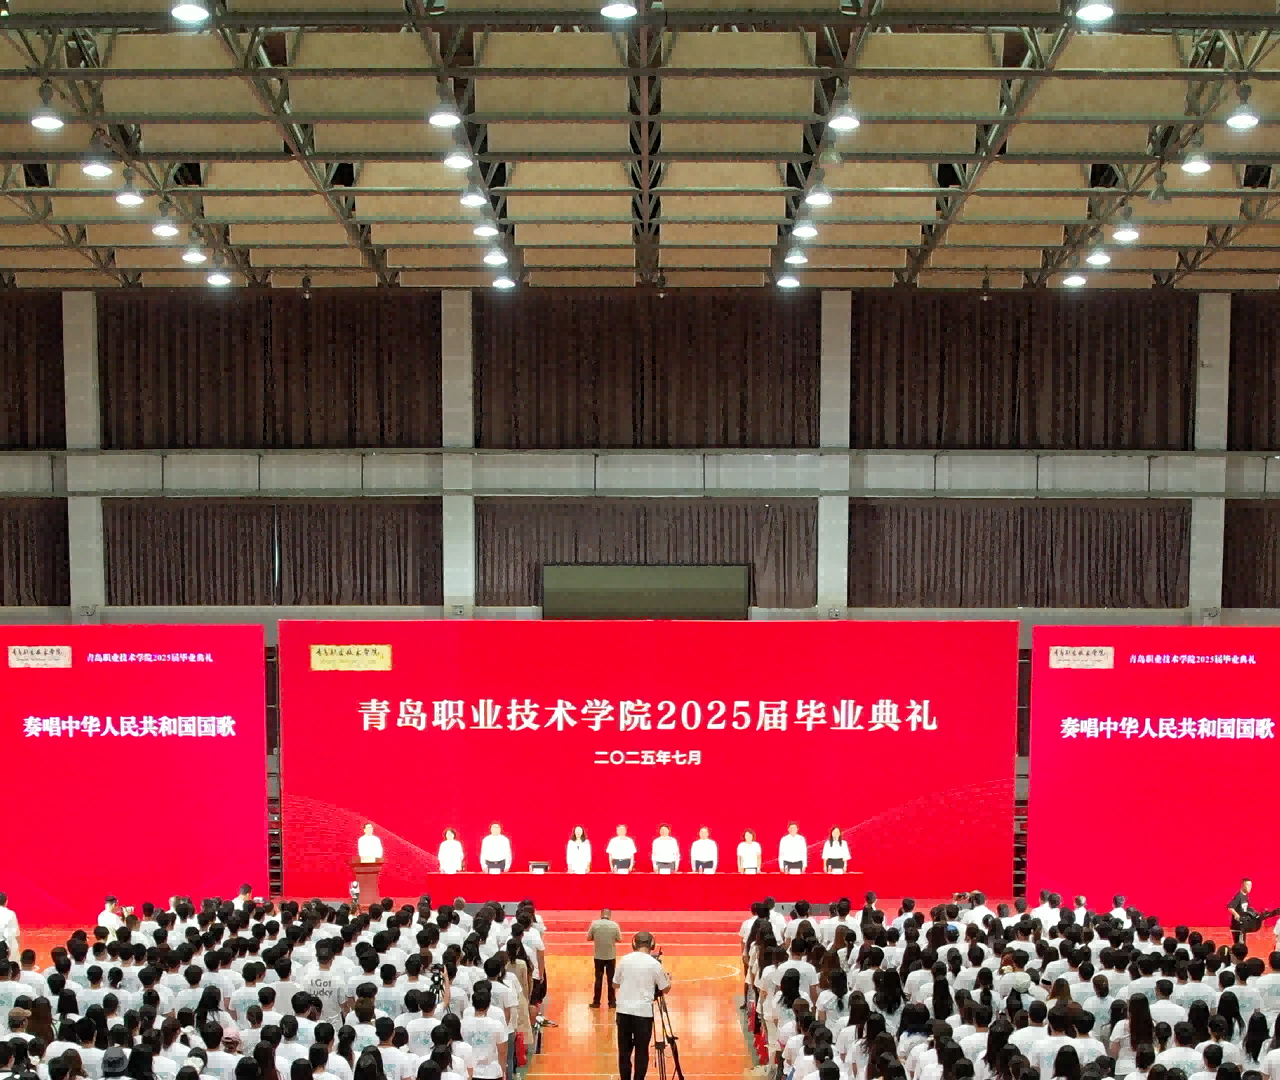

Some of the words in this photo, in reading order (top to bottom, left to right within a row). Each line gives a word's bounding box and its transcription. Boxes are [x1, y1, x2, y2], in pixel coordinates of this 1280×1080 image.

[87, 652, 213, 663] 青岛职业技术学院2025届毕业典礼
[1129, 654, 1256, 664] 青岛职业技术学院2025届毕业典礼
[358, 698, 938, 732] 青岛职业技术学院2025届毕业典礼
[22, 715, 237, 738] 奏唱中华人民共和国国歌
[1060, 716, 1276, 740] 奏唱中华人民共和国国歌
[315, 979, 331, 987] Got
